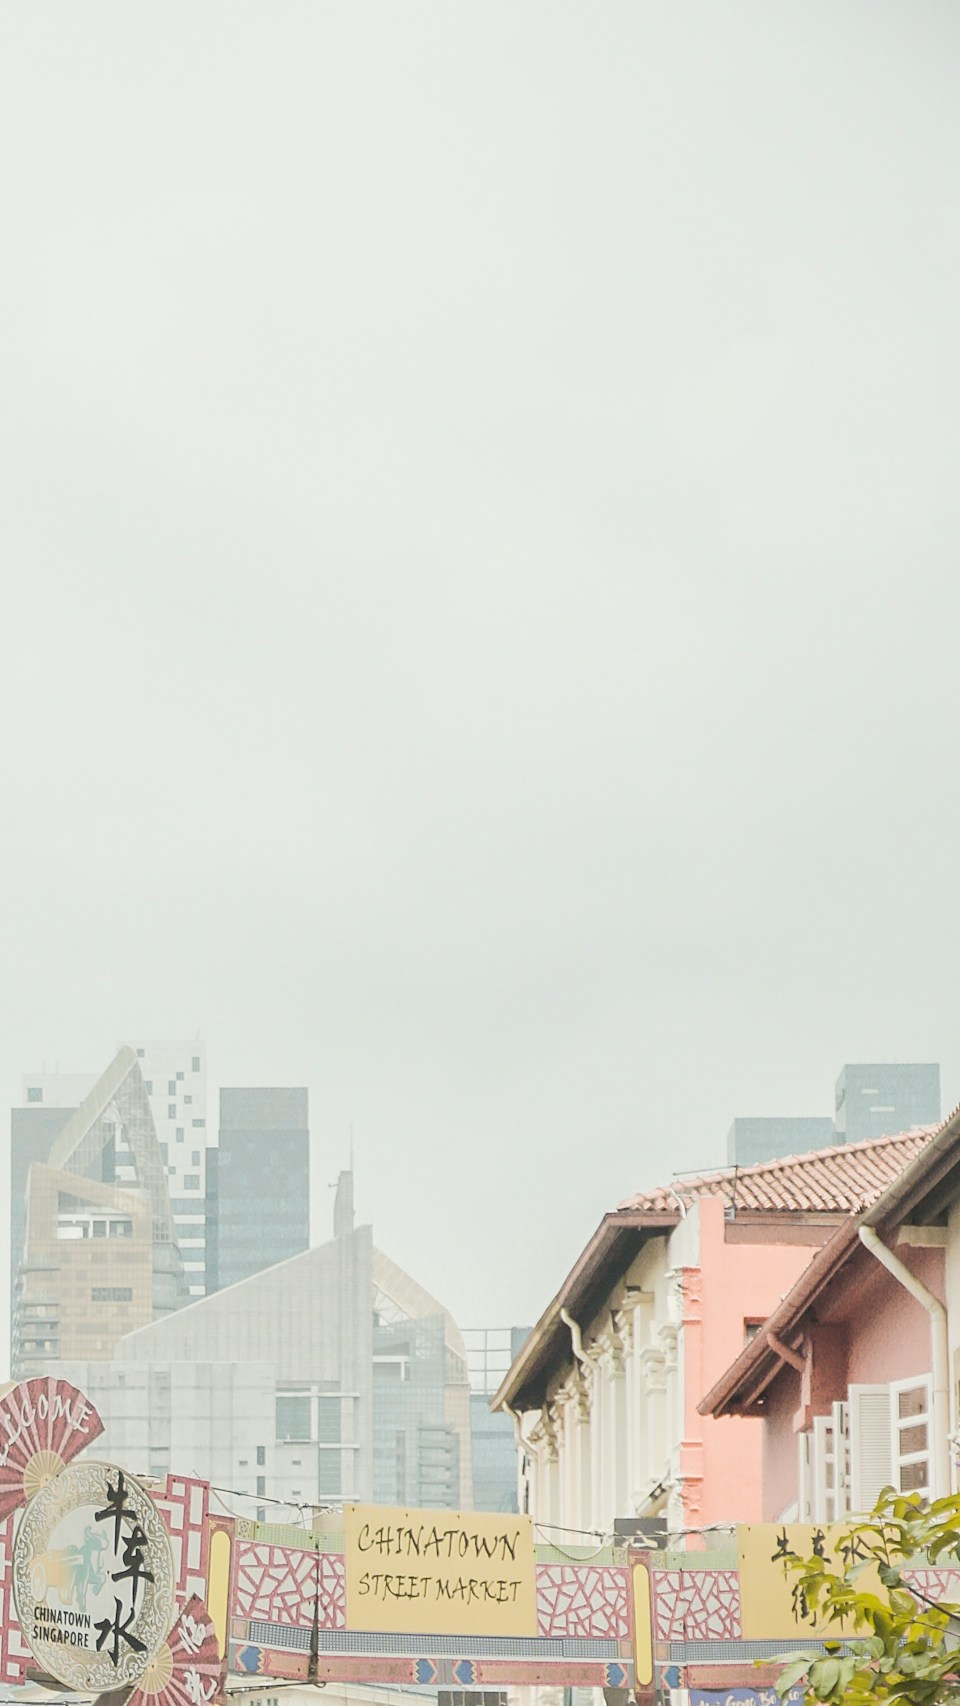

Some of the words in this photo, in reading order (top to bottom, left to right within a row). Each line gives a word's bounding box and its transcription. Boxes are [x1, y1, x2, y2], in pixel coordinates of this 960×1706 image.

[358, 1524, 520, 1561] CHINATOWN
[93, 1470, 154, 1667] 牛车水
[358, 1572, 432, 1601] STREET
[436, 1577, 522, 1605] MARKET
[34, 1606, 91, 1629] CHINATOWN
[32, 1625, 89, 1648] SINGAPORE
